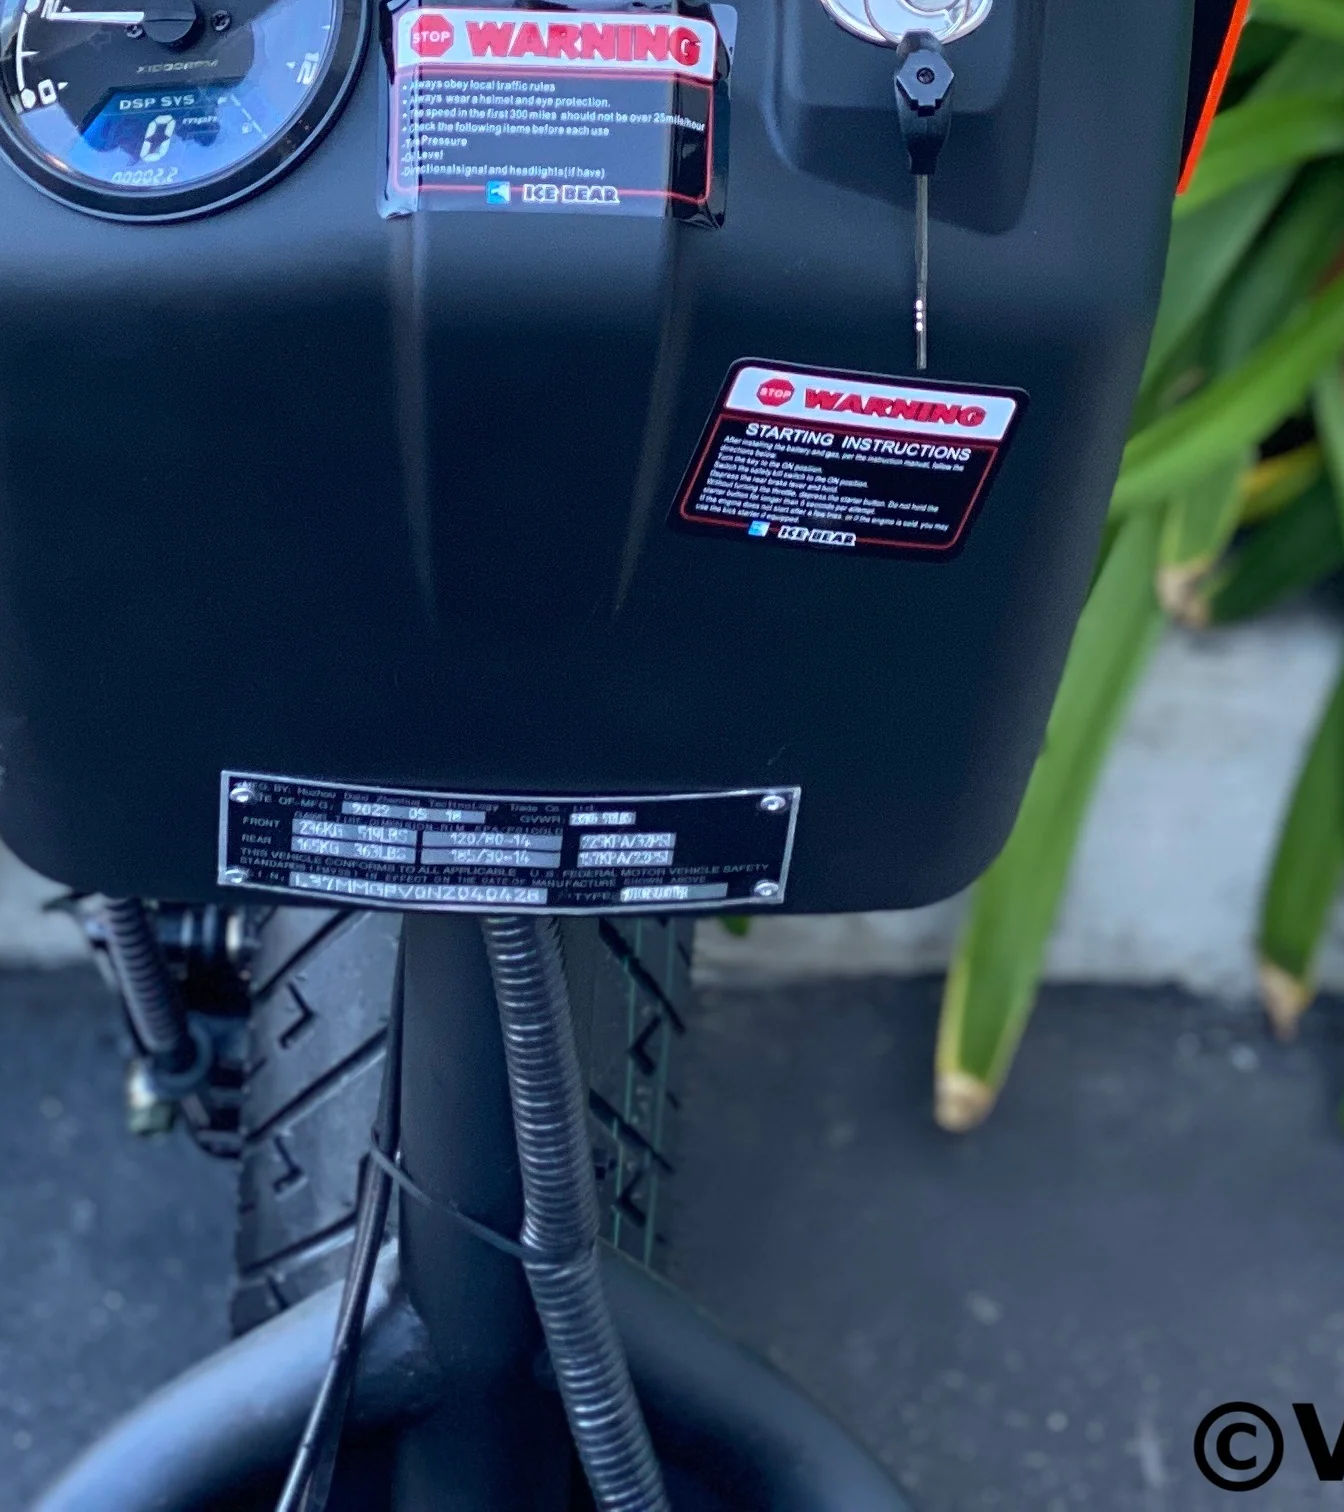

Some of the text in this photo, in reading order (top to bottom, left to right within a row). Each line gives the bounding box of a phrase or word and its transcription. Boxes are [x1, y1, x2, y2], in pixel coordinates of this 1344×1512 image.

[412, 30, 451, 44] STOP
[465, 20, 702, 67] WARNING
[444, 79, 469, 92] obey
[470, 80, 495, 90] local
[119, 94, 195, 110] DSP SYS
[445, 95, 470, 104] wear
[426, 109, 456, 120] speed
[469, 109, 485, 118] the
[487, 109, 508, 119] first
[510, 109, 527, 119] 300
[560, 112, 596, 121] should
[597, 113, 614, 123] not
[616, 113, 628, 123] be
[630, 115, 652, 123] over
[438, 122, 454, 131] the
[455, 122, 502, 136] following
[532, 125, 564, 137] before
[566, 126, 589, 136] each
[590, 127, 610, 136] use
[140, 114, 176, 163] 0
[523, 184, 620, 204] ICE BEAR
[759, 388, 792, 398] STOP
[804, 388, 986, 427] WARNING
[745, 423, 835, 447] STARTING
[841, 435, 972, 462] INSTRUCTIONS
[777, 524, 809, 544] ICE
[352, 805, 391, 819] 2022
